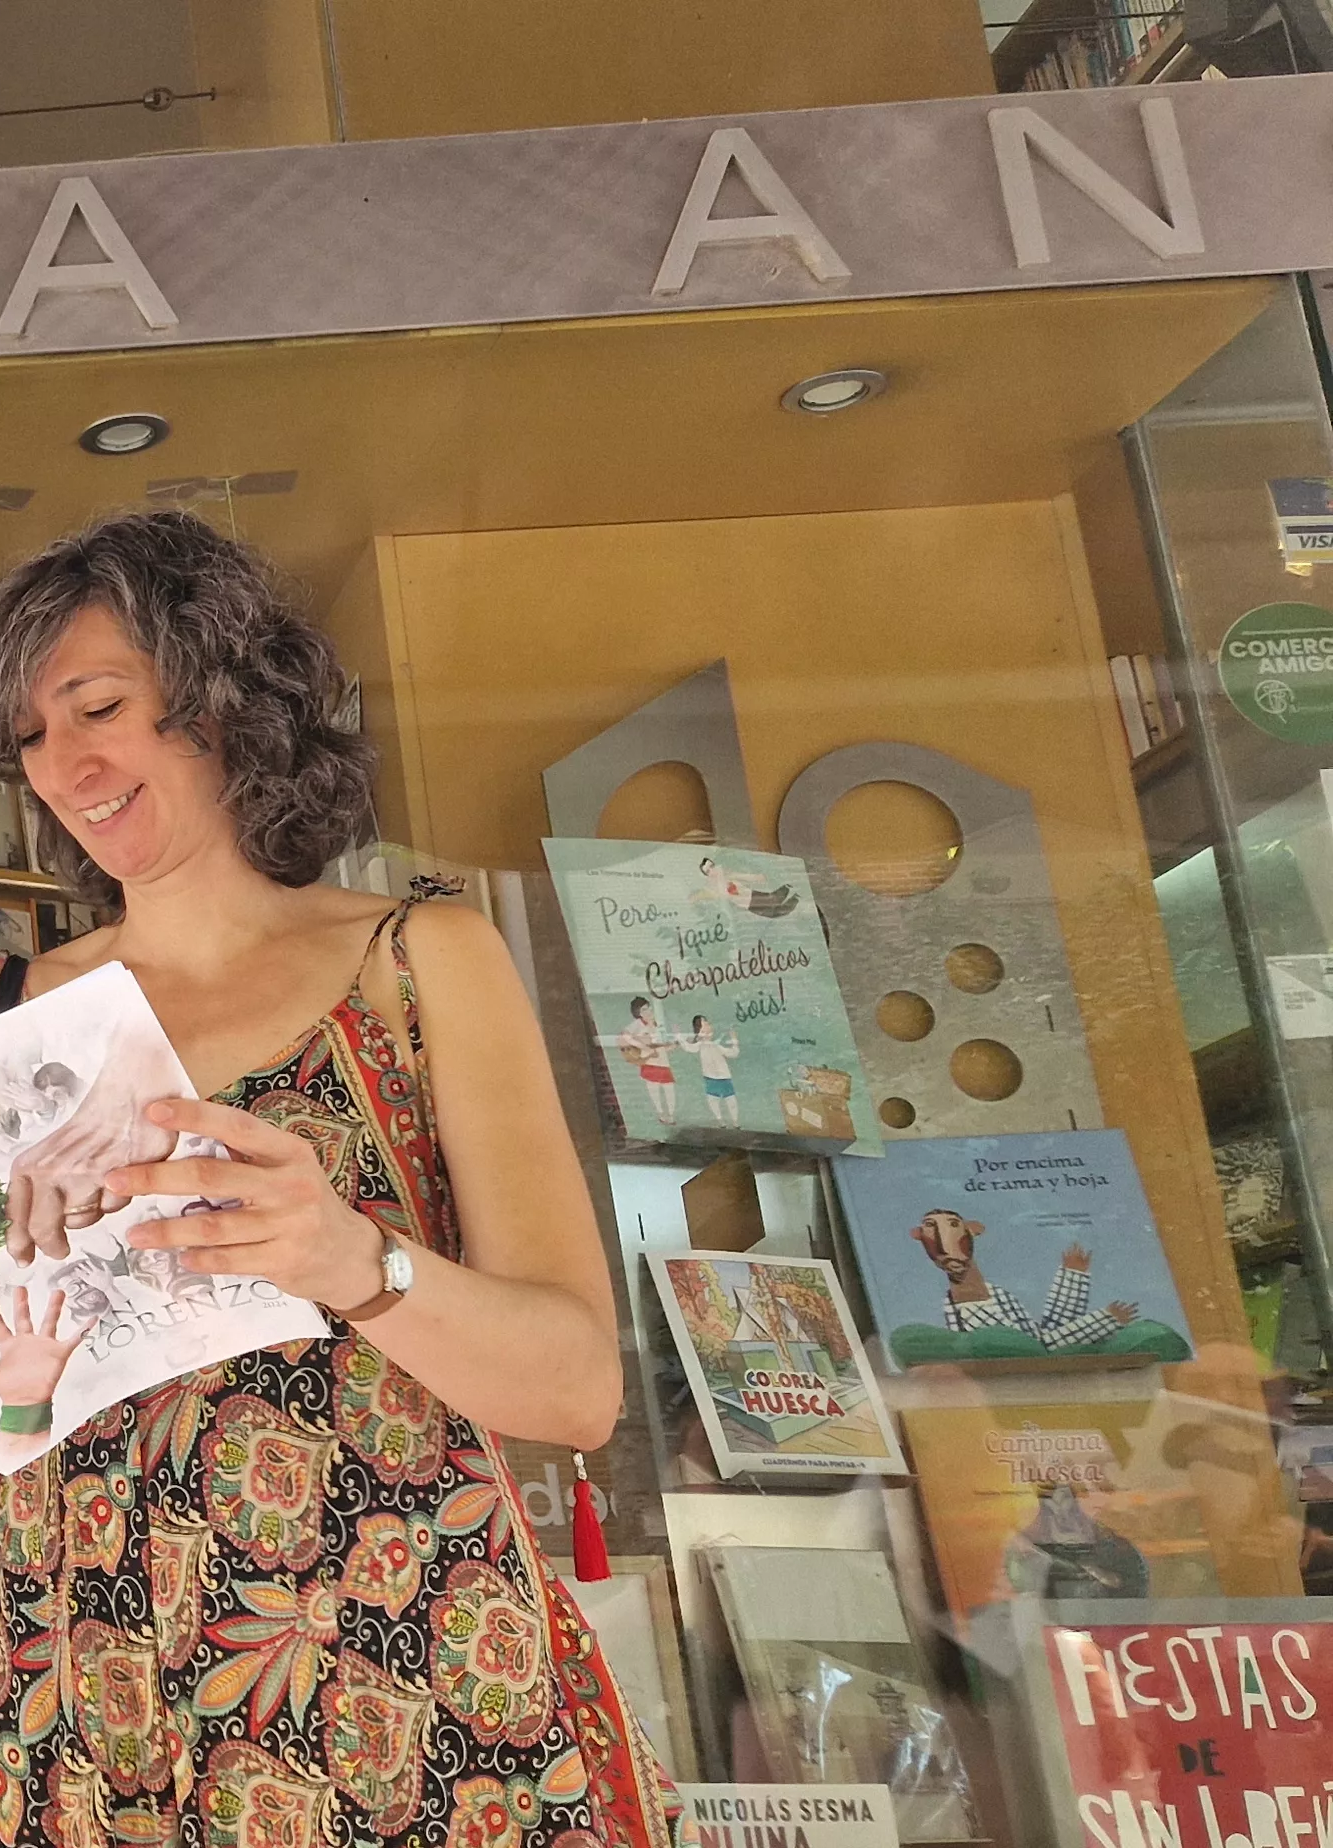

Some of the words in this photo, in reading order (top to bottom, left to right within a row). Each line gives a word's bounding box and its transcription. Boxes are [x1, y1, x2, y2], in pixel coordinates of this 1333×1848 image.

[646, 940, 811, 999] Chorpatélicos
[736, 978, 787, 1022] sois!
[974, 1158, 1009, 1174] Por
[1015, 1155, 1085, 1170] encima
[964, 1178, 986, 1192] de
[990, 1178, 1044, 1191] rama
[1044, 1178, 1059, 1193] y
[80, 1299, 137, 1347] SAN
[86, 1279, 283, 1365] LORENZO
[745, 1370, 826, 1390] COLOREA
[741, 1391, 845, 1417] HUESCA
[985, 1430, 1103, 1462] Campana
[998, 1459, 1104, 1484] Huesca
[1054, 1626, 1317, 1729] FIESTAS
[1178, 1738, 1225, 1777] DE
[694, 1795, 792, 1822] NICOLÁS
[799, 1798, 875, 1822] SESMA
[1079, 1789, 1183, 1848] SAN
